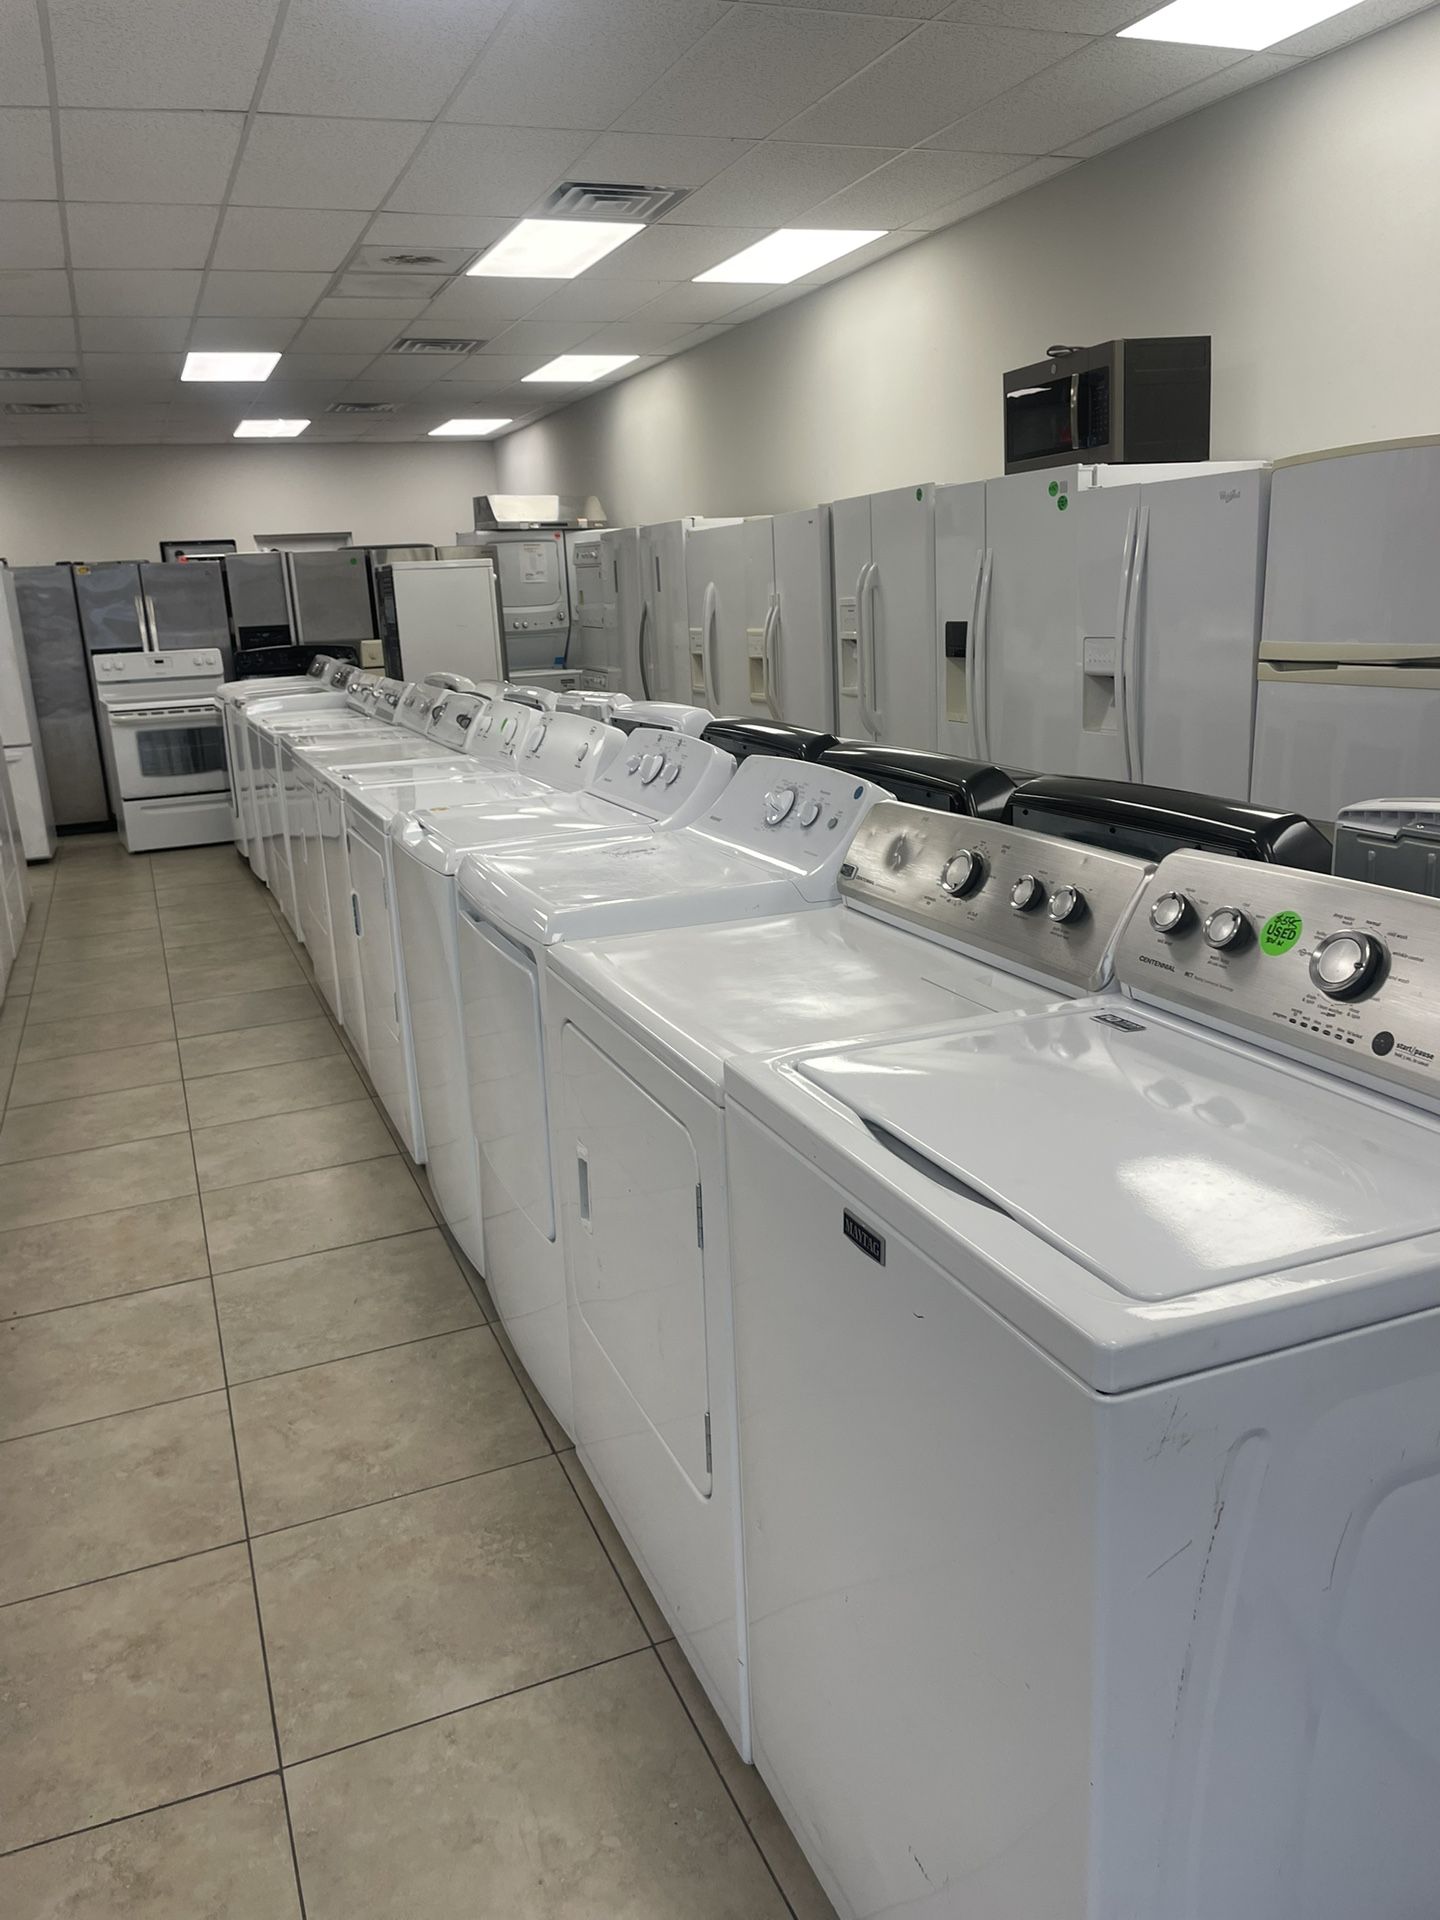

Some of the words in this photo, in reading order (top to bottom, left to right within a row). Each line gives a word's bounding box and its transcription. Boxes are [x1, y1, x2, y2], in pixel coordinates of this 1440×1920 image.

[1266, 923, 1297, 941] USED
[1138, 954, 1176, 973] CENTENNIAL
[1395, 1042, 1435, 1060] start/pause
